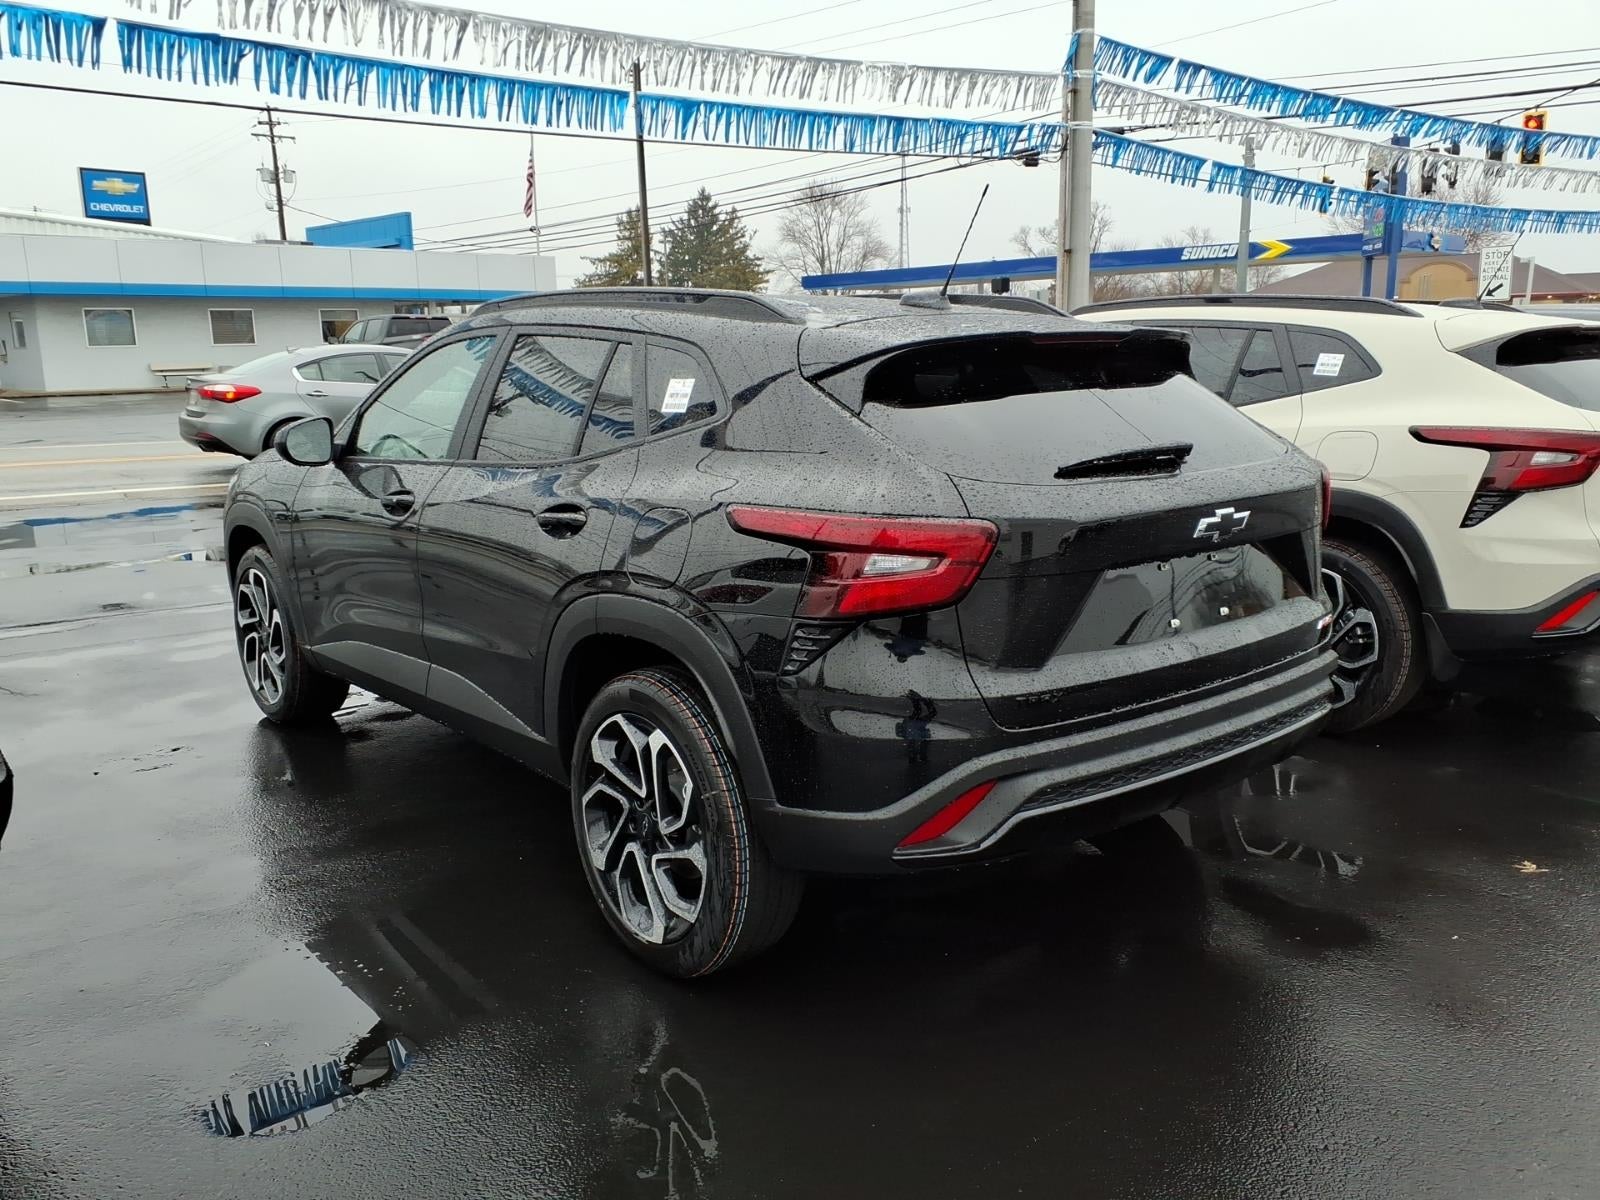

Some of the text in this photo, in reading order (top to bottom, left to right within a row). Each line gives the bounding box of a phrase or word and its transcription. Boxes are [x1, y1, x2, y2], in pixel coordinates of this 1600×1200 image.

[90, 202, 145, 213] CHEVROLET
[1181, 244, 1239, 260] SUNOCO
[1484, 251, 1510, 260] STOP
